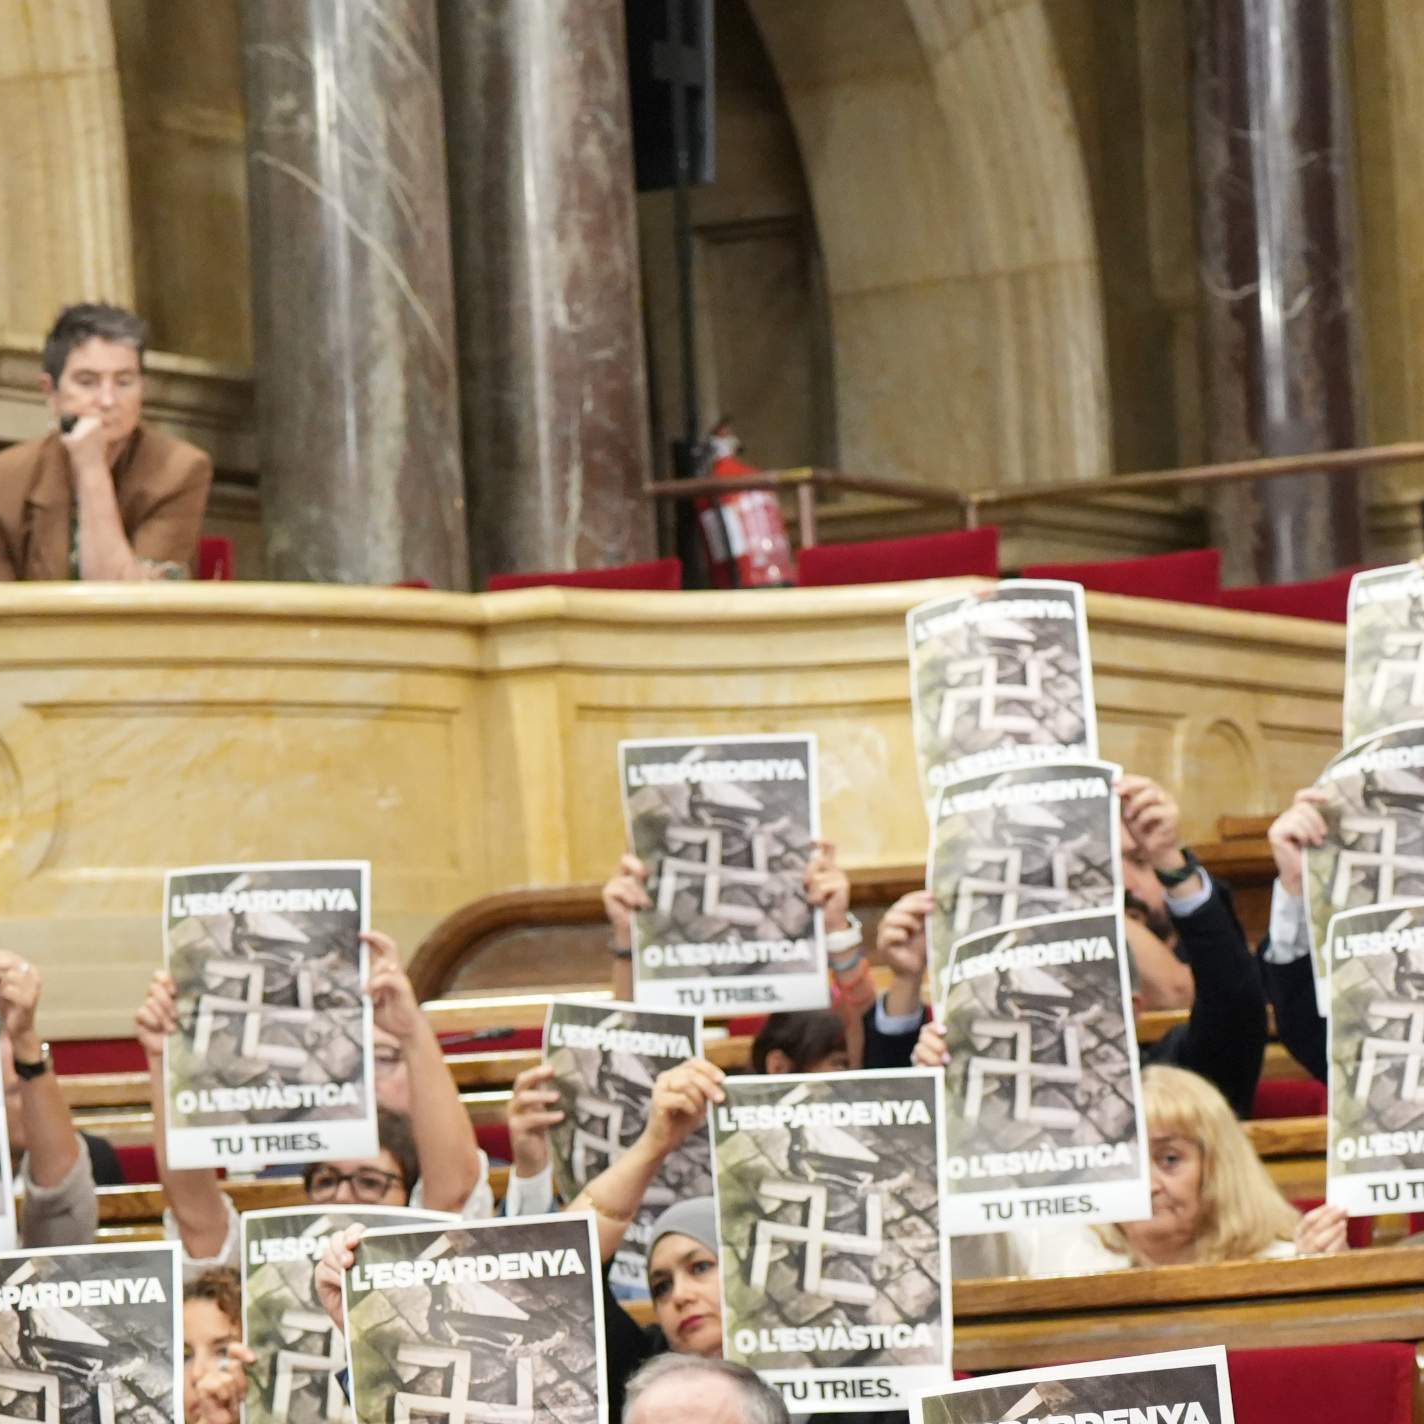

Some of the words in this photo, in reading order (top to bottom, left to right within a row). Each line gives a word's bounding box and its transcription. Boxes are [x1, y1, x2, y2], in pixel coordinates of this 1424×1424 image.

[1369, 1182, 1400, 1201] TU
[351, 1248, 585, 1291] L'ESPARDENYA
[814, 1378, 899, 1398] TRIES.
